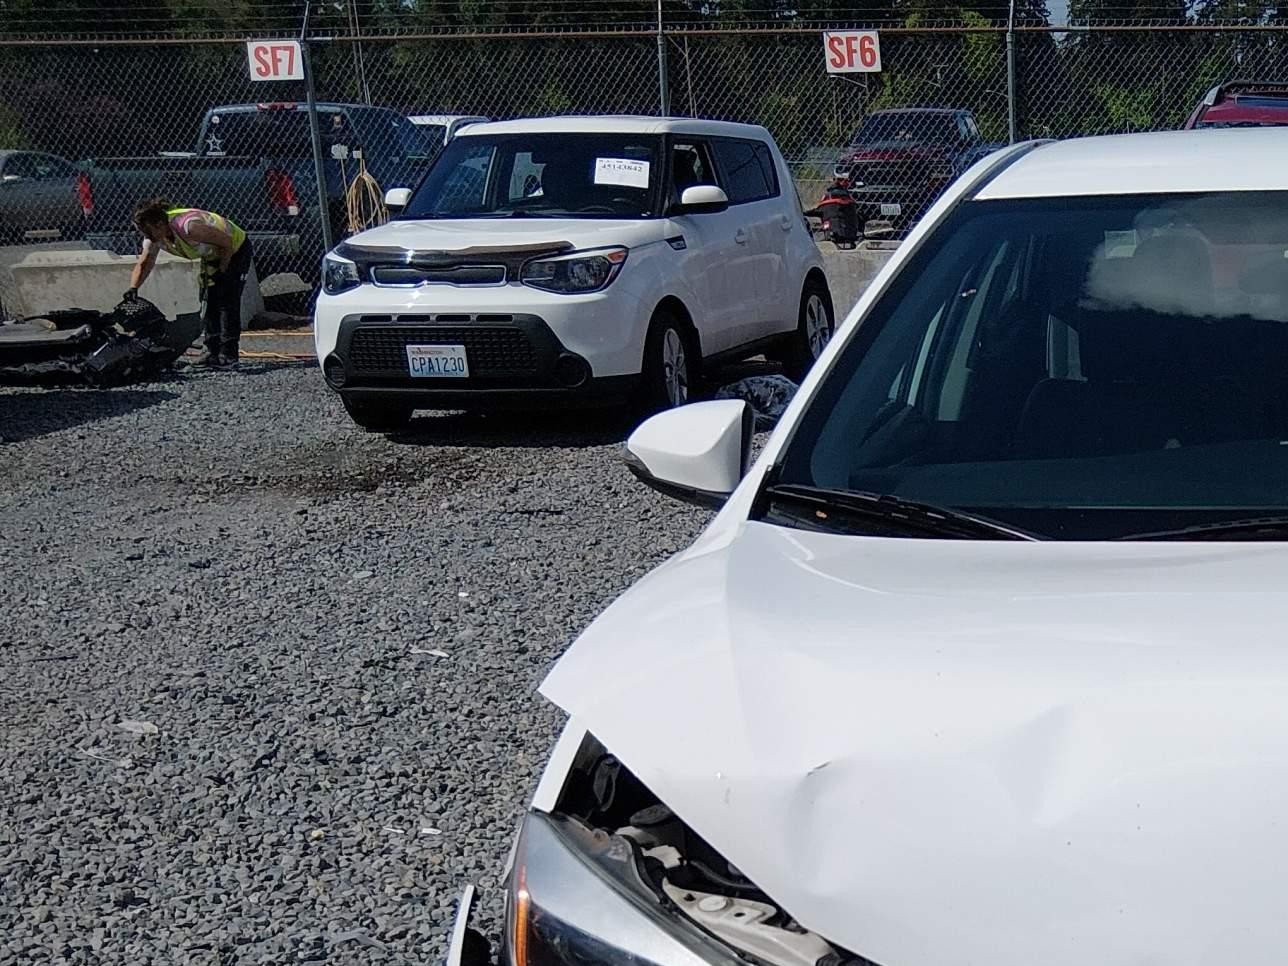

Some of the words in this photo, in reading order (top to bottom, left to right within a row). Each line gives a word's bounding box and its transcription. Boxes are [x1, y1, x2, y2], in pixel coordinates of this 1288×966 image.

[254, 45, 295, 77] SF7
[828, 36, 876, 68] SF6
[411, 357, 465, 373] CPA1230
